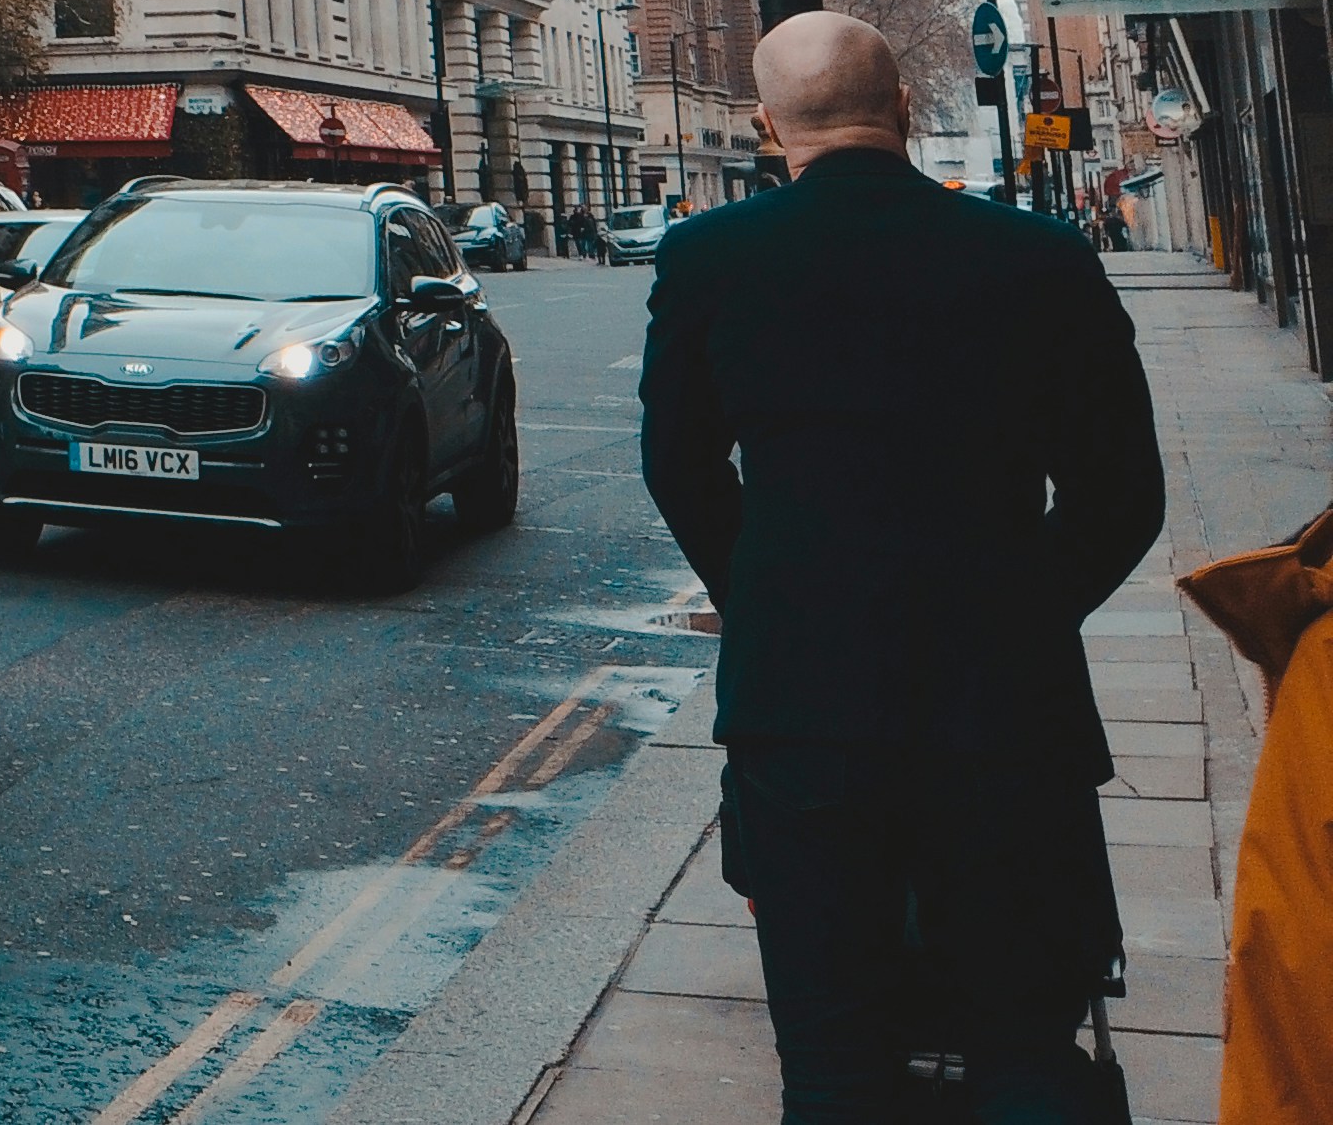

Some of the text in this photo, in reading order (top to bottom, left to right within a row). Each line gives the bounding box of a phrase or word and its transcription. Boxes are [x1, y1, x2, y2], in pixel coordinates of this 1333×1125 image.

[124, 363, 148, 375] KIA
[88, 447, 190, 475] LM16 VCX
